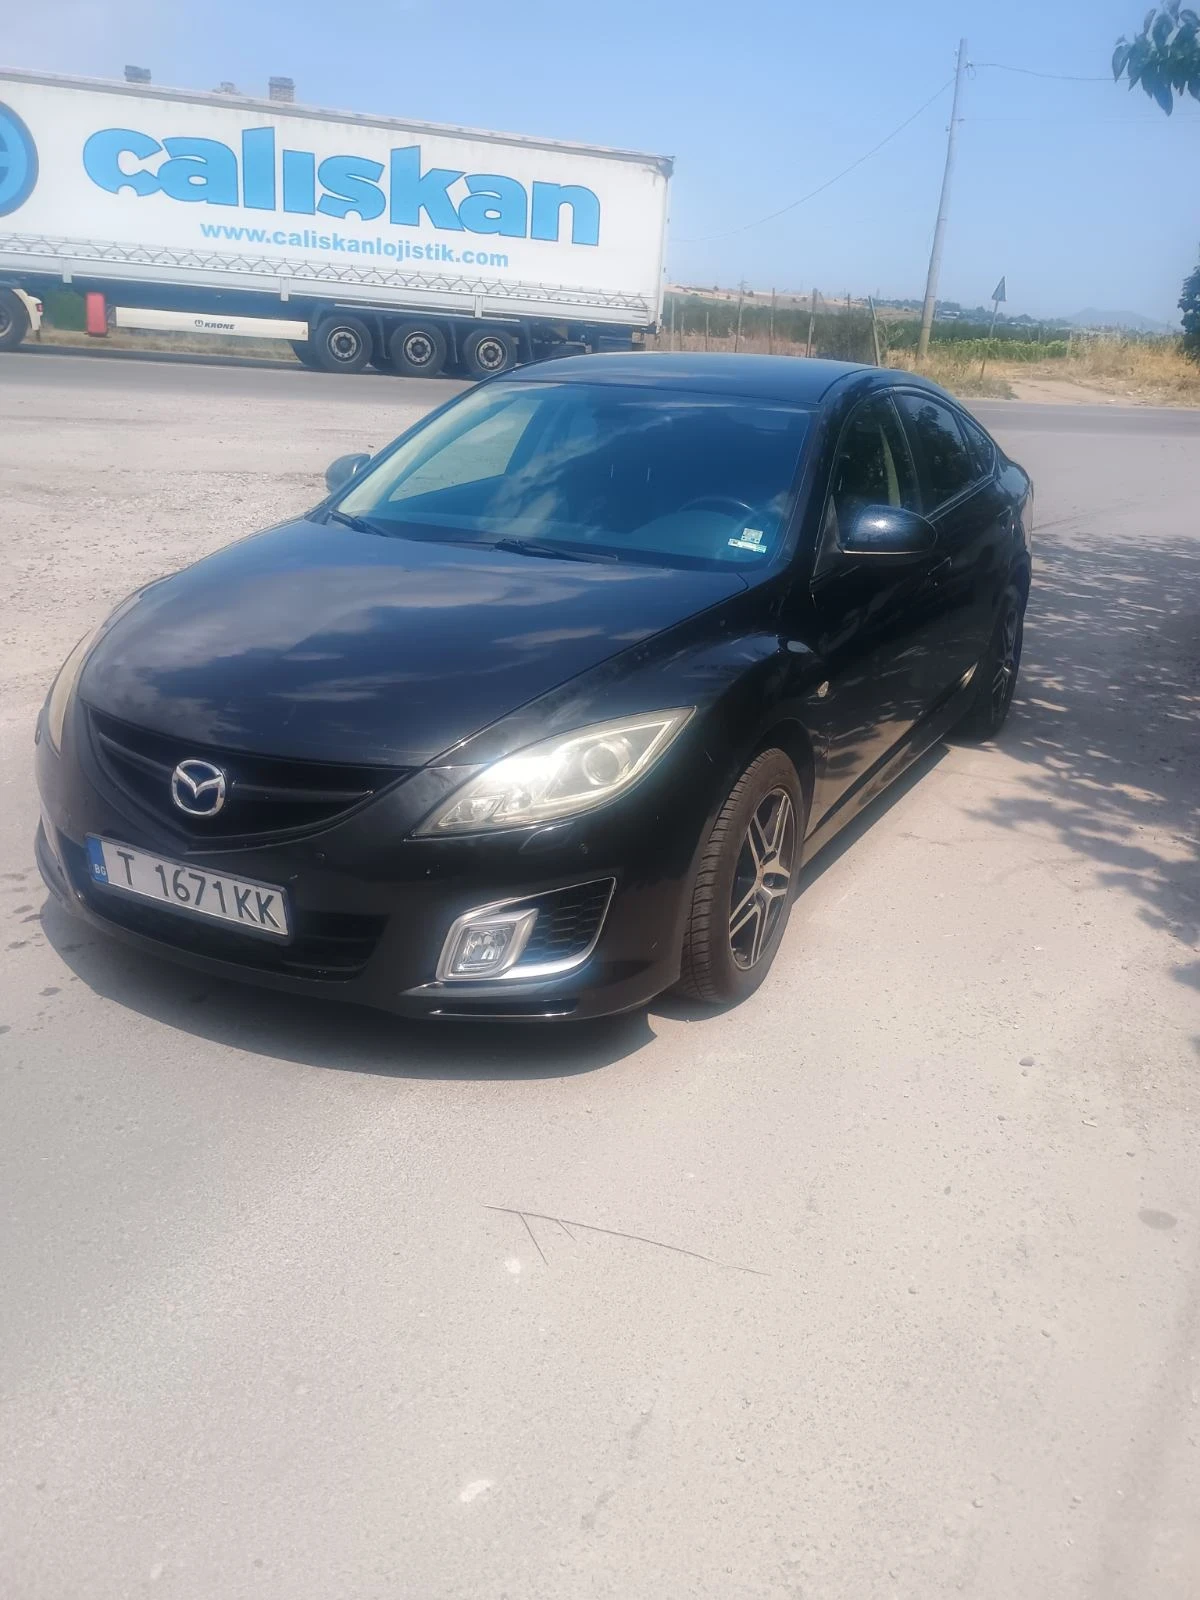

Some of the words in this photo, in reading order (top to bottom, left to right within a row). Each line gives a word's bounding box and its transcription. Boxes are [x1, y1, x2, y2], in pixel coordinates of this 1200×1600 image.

[200, 223, 508, 268] www.caliskanlojistik.com
[204, 322, 235, 330] KRONE
[94, 863, 106, 876] BG
[117, 851, 134, 886] T
